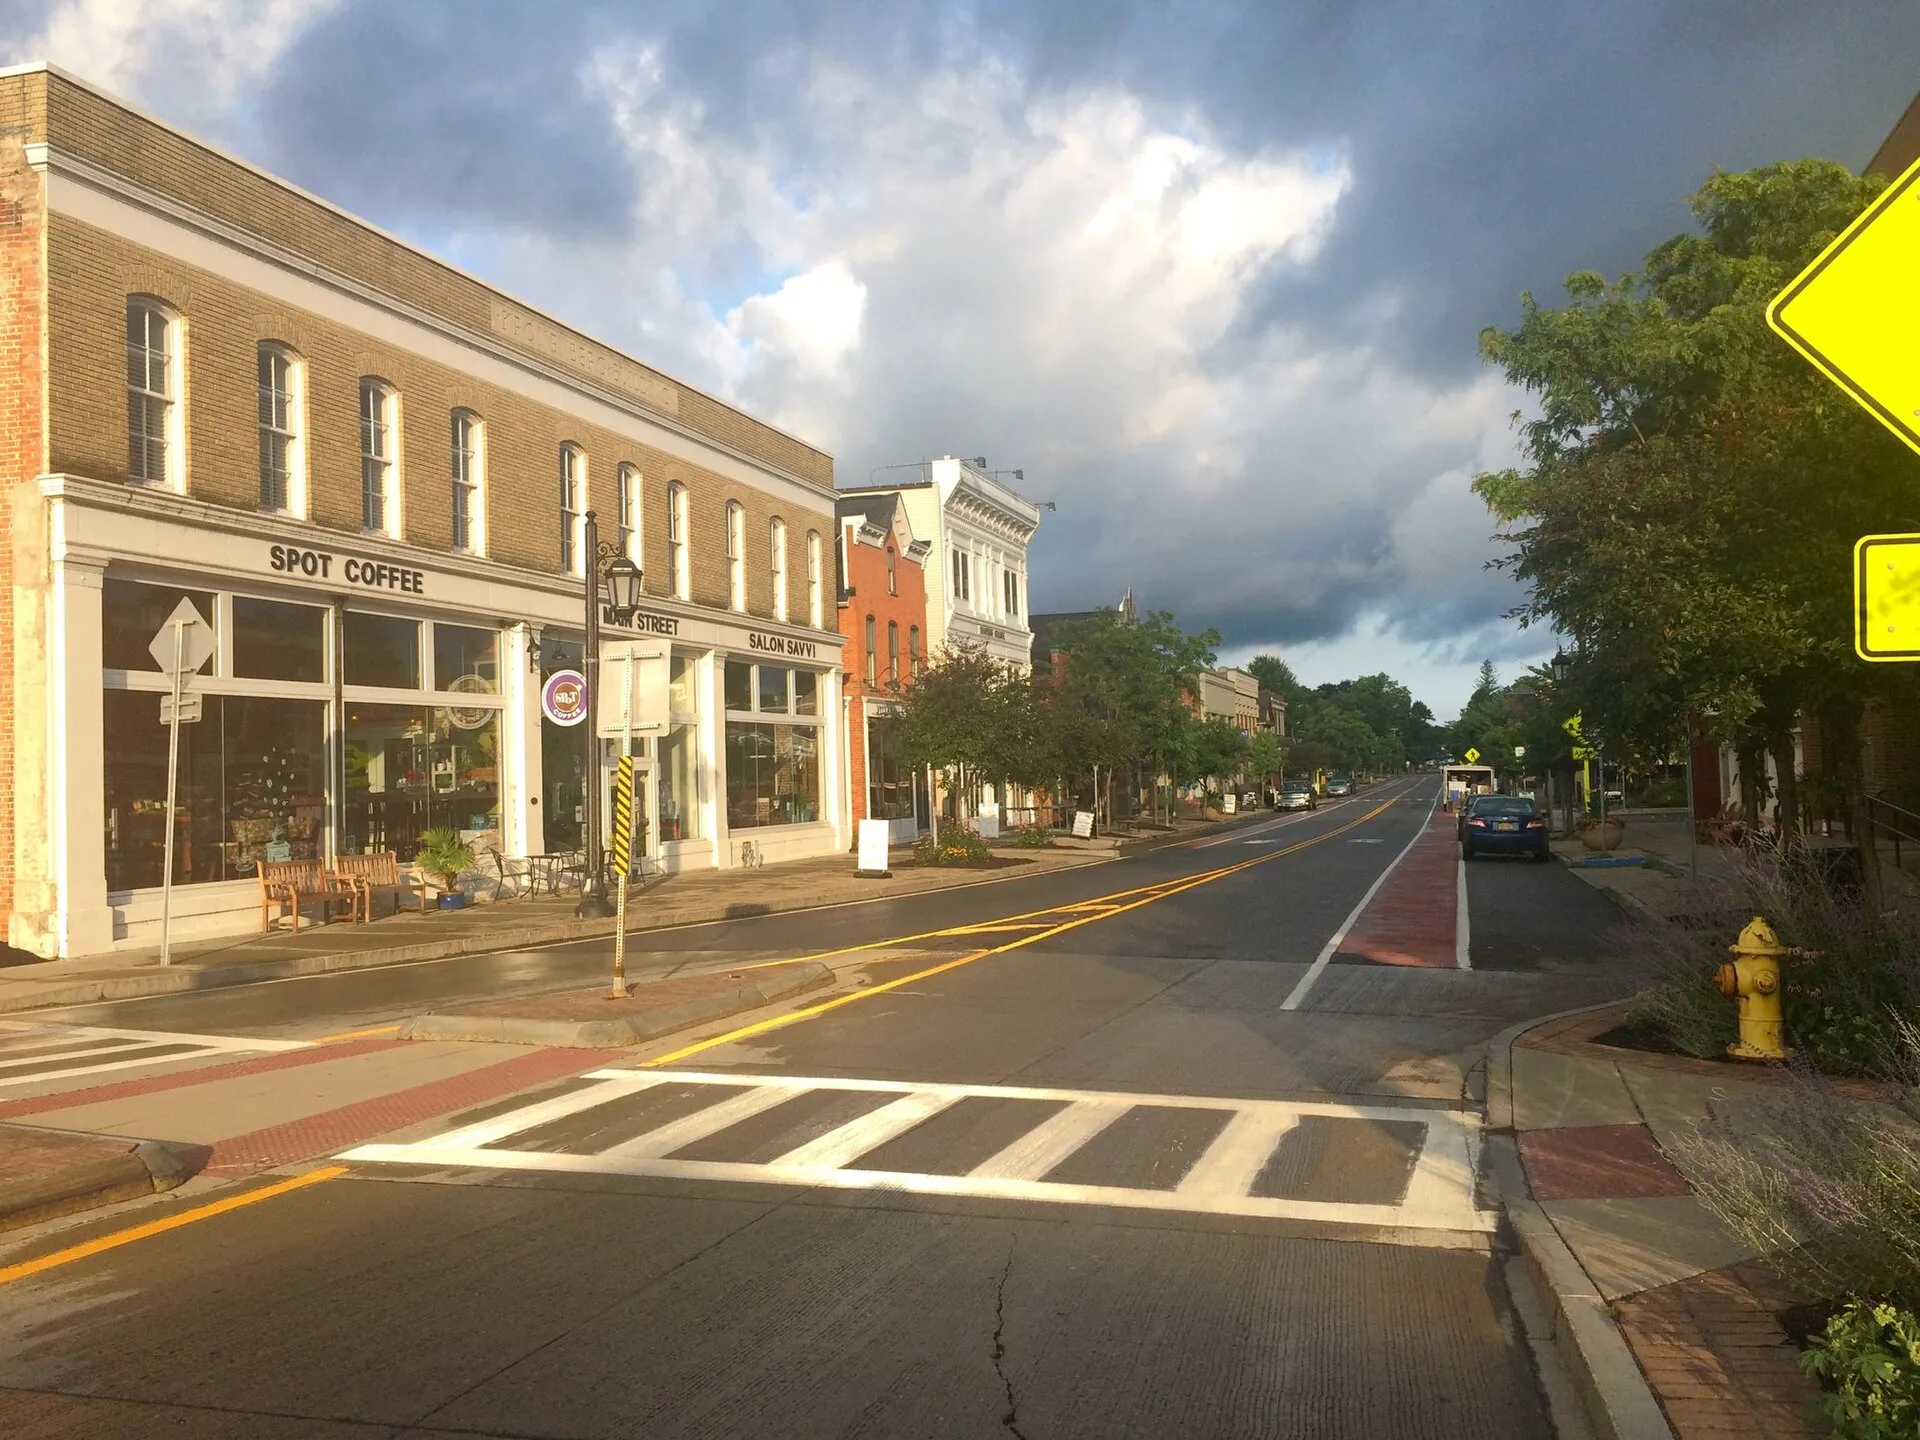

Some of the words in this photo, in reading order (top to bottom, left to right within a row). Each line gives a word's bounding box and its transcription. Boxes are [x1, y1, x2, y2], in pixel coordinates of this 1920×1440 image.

[270, 545, 333, 578] SPOT
[344, 559, 424, 594] COFFEE
[637, 612, 680, 636] STREET
[749, 633, 785, 653] SALON
[787, 640, 816, 658] SAVVI
[553, 708, 581, 719] COFFEE
